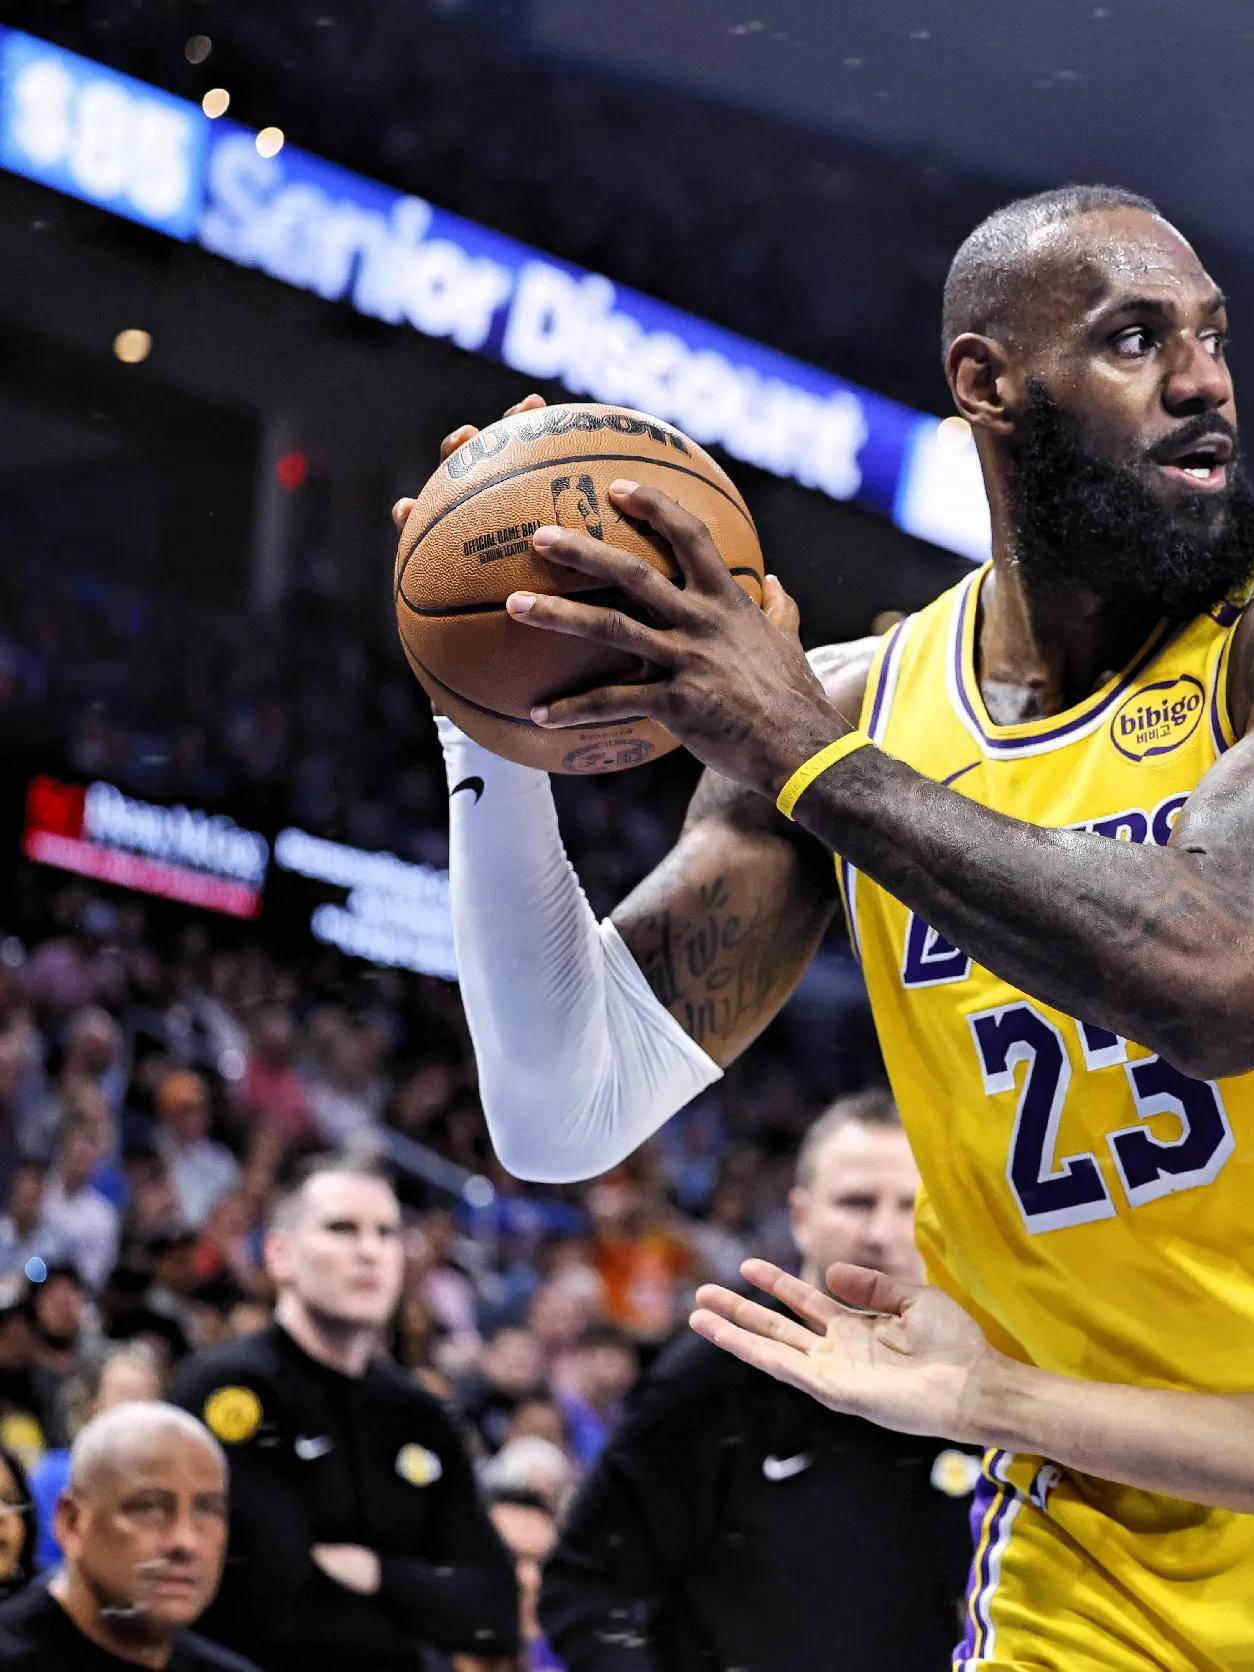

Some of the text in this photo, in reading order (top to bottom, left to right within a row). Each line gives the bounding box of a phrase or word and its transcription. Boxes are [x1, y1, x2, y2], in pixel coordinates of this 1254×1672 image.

[502, 262, 867, 499] Discount
[1120, 694, 1200, 735] bibigo
[1136, 724, 1171, 744] 비비고
[967, 1000, 1236, 1235] 23
